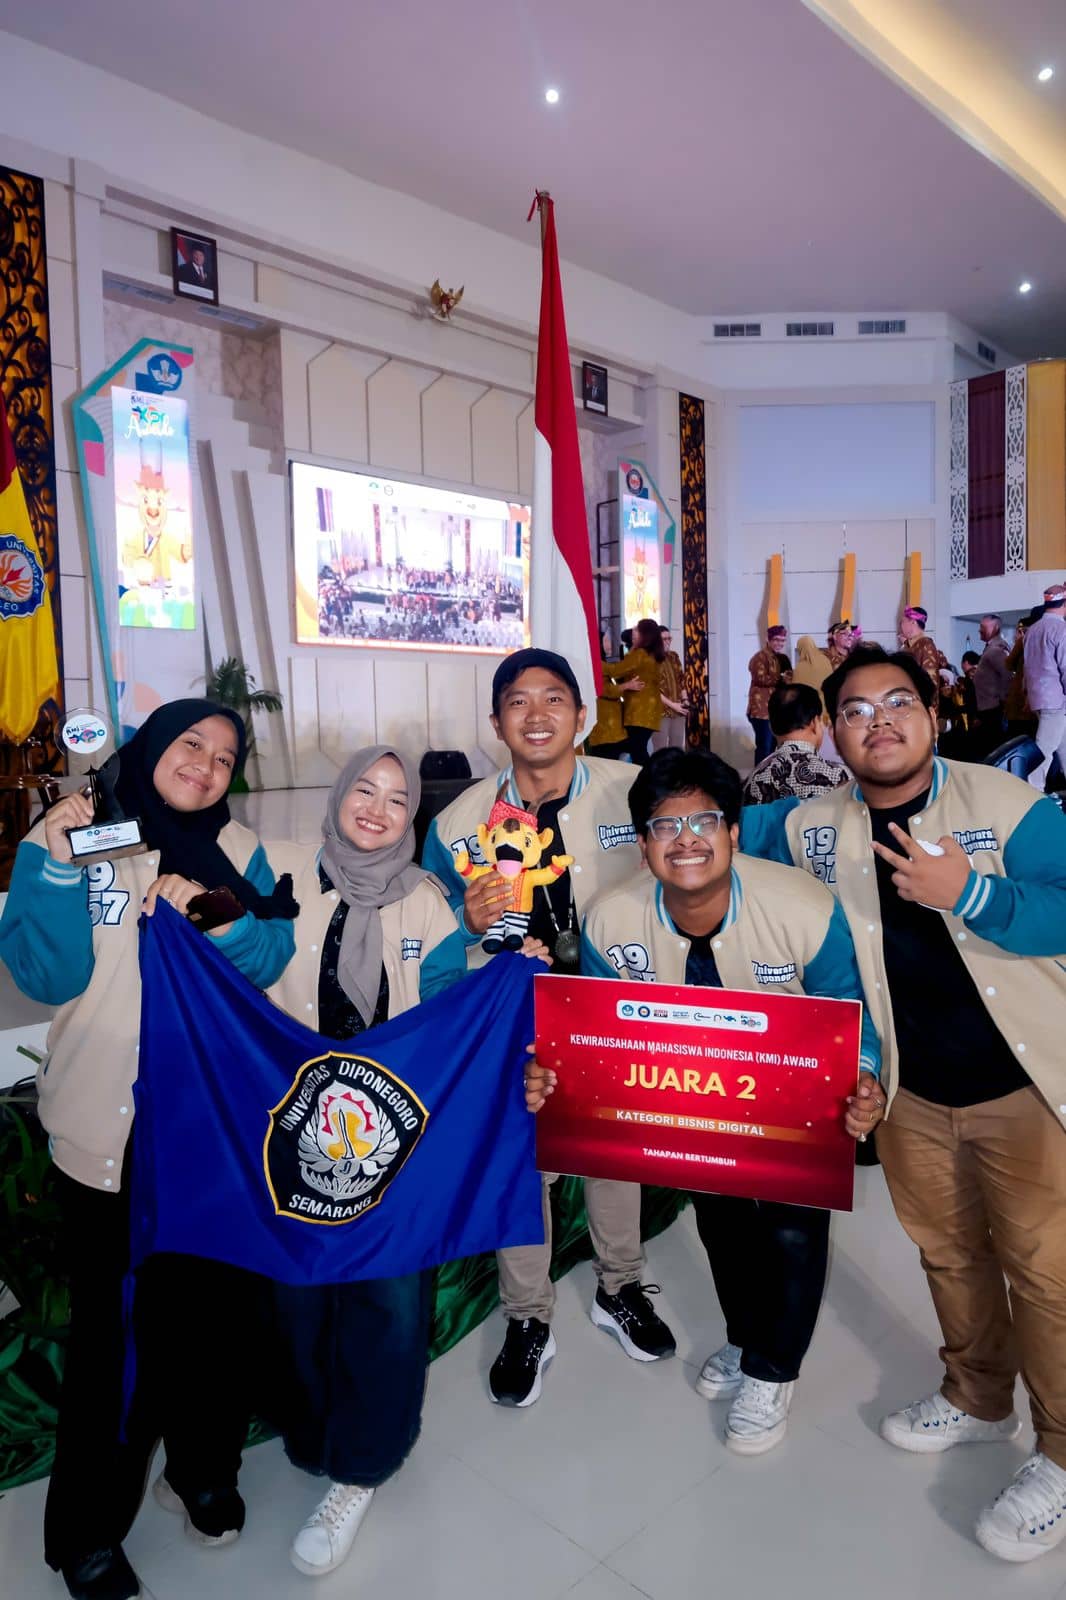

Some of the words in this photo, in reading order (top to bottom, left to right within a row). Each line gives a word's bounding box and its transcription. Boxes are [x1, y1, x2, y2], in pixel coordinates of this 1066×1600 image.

[803, 826, 837, 858] 19
[82, 860, 115, 892] 9
[606, 943, 649, 972] 19
[570, 1034, 645, 1051] KEWIRAUSAHAAN
[647, 1041, 703, 1057] MAHASISWA
[704, 1047, 754, 1062] INDONESIA
[755, 1051, 781, 1066] (KMI)
[782, 1054, 818, 1068] AWARD
[338, 1061, 419, 1131] DIPONEGORO
[623, 1063, 727, 1097] JUARA
[736, 1075, 756, 1100] 2
[279, 1064, 331, 1132] UNIVERSITAS
[616, 1110, 674, 1126] KATEGORI
[678, 1117, 715, 1130] BISNIS
[718, 1121, 765, 1136] DIGITAL
[643, 1148, 683, 1160] TAHAPAN
[685, 1153, 736, 1167] BERTUMBUH
[289, 1193, 372, 1218] SEMARANG
